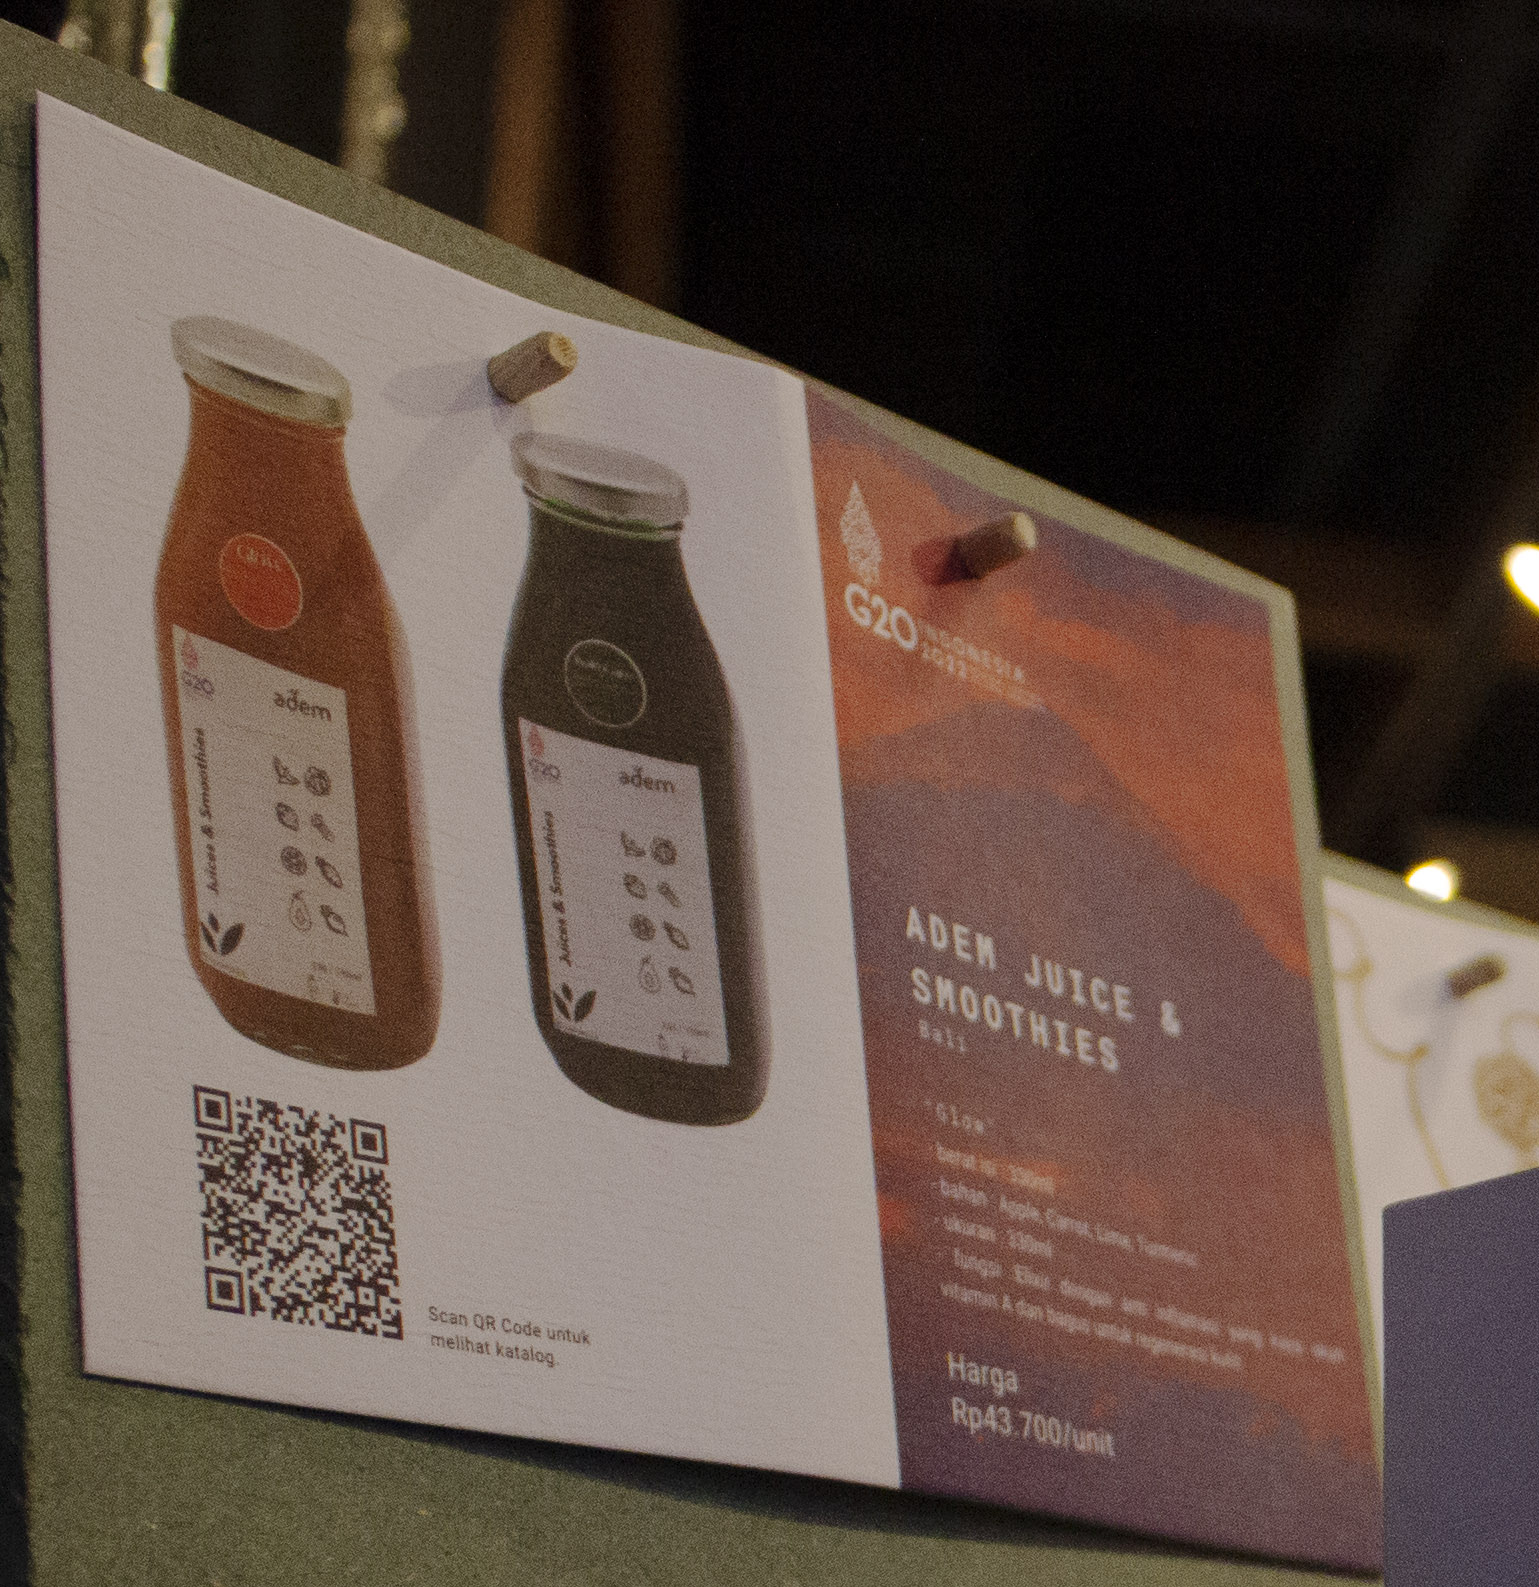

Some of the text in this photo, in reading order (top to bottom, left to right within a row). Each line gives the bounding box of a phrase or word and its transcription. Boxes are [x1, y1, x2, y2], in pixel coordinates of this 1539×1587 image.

[844, 583, 919, 651] G20
[191, 727, 219, 895] Juices & Smoothies
[541, 811, 573, 968] Juices & Smoothies
[906, 906, 1181, 1037] ADEM JUICE &
[911, 968, 1121, 1072] SMOOTHIES
[918, 1018, 968, 1053] Bali
[428, 1305, 592, 1347] Scan QR Code untuk
[430, 1332, 492, 1357] melihat
[947, 1352, 1020, 1397] Harga
[952, 1398, 1116, 1459] Rp43.700/unit
